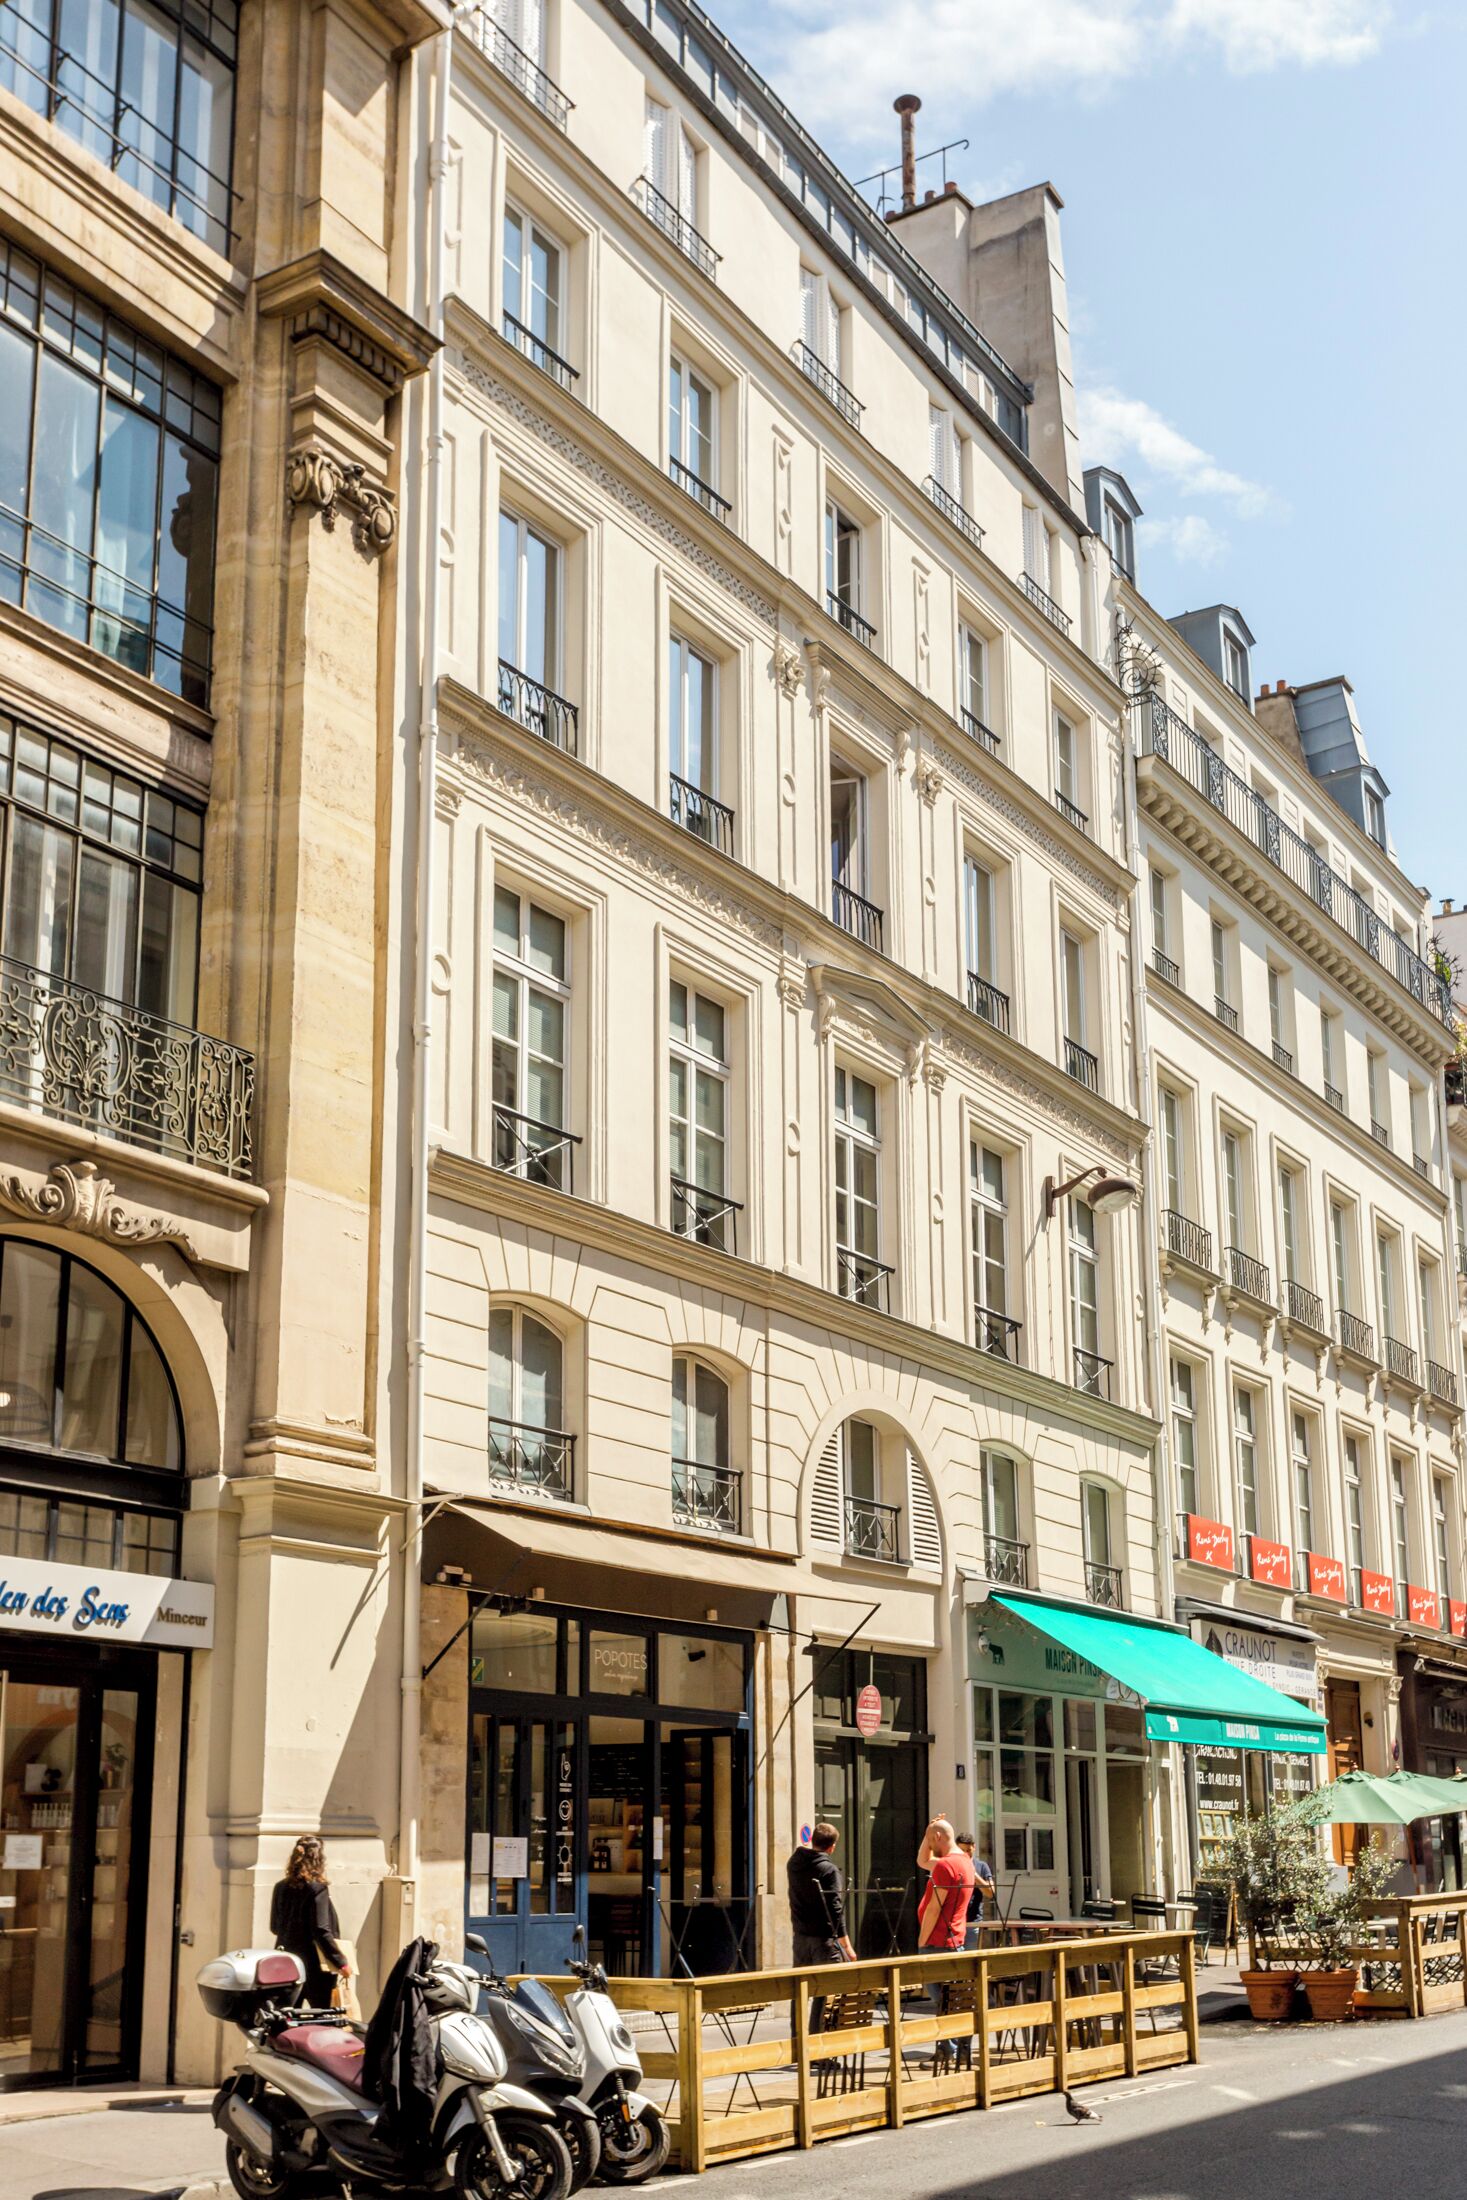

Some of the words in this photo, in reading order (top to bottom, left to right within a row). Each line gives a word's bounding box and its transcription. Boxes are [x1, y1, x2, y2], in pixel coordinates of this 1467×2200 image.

[32, 1586, 70, 1617] des
[75, 1585, 130, 1625] Sens
[157, 1606, 208, 1627] Minceur
[1225, 1631, 1277, 1662] CRAUNOT
[594, 1648, 648, 1670] POPOTES
[1045, 1647, 1077, 1674] MAISON
[1248, 1662, 1276, 1679] DROITE
[1225, 1722, 1245, 1739] MAISON
[1199, 1798, 1239, 1811] www.craunot.fr
